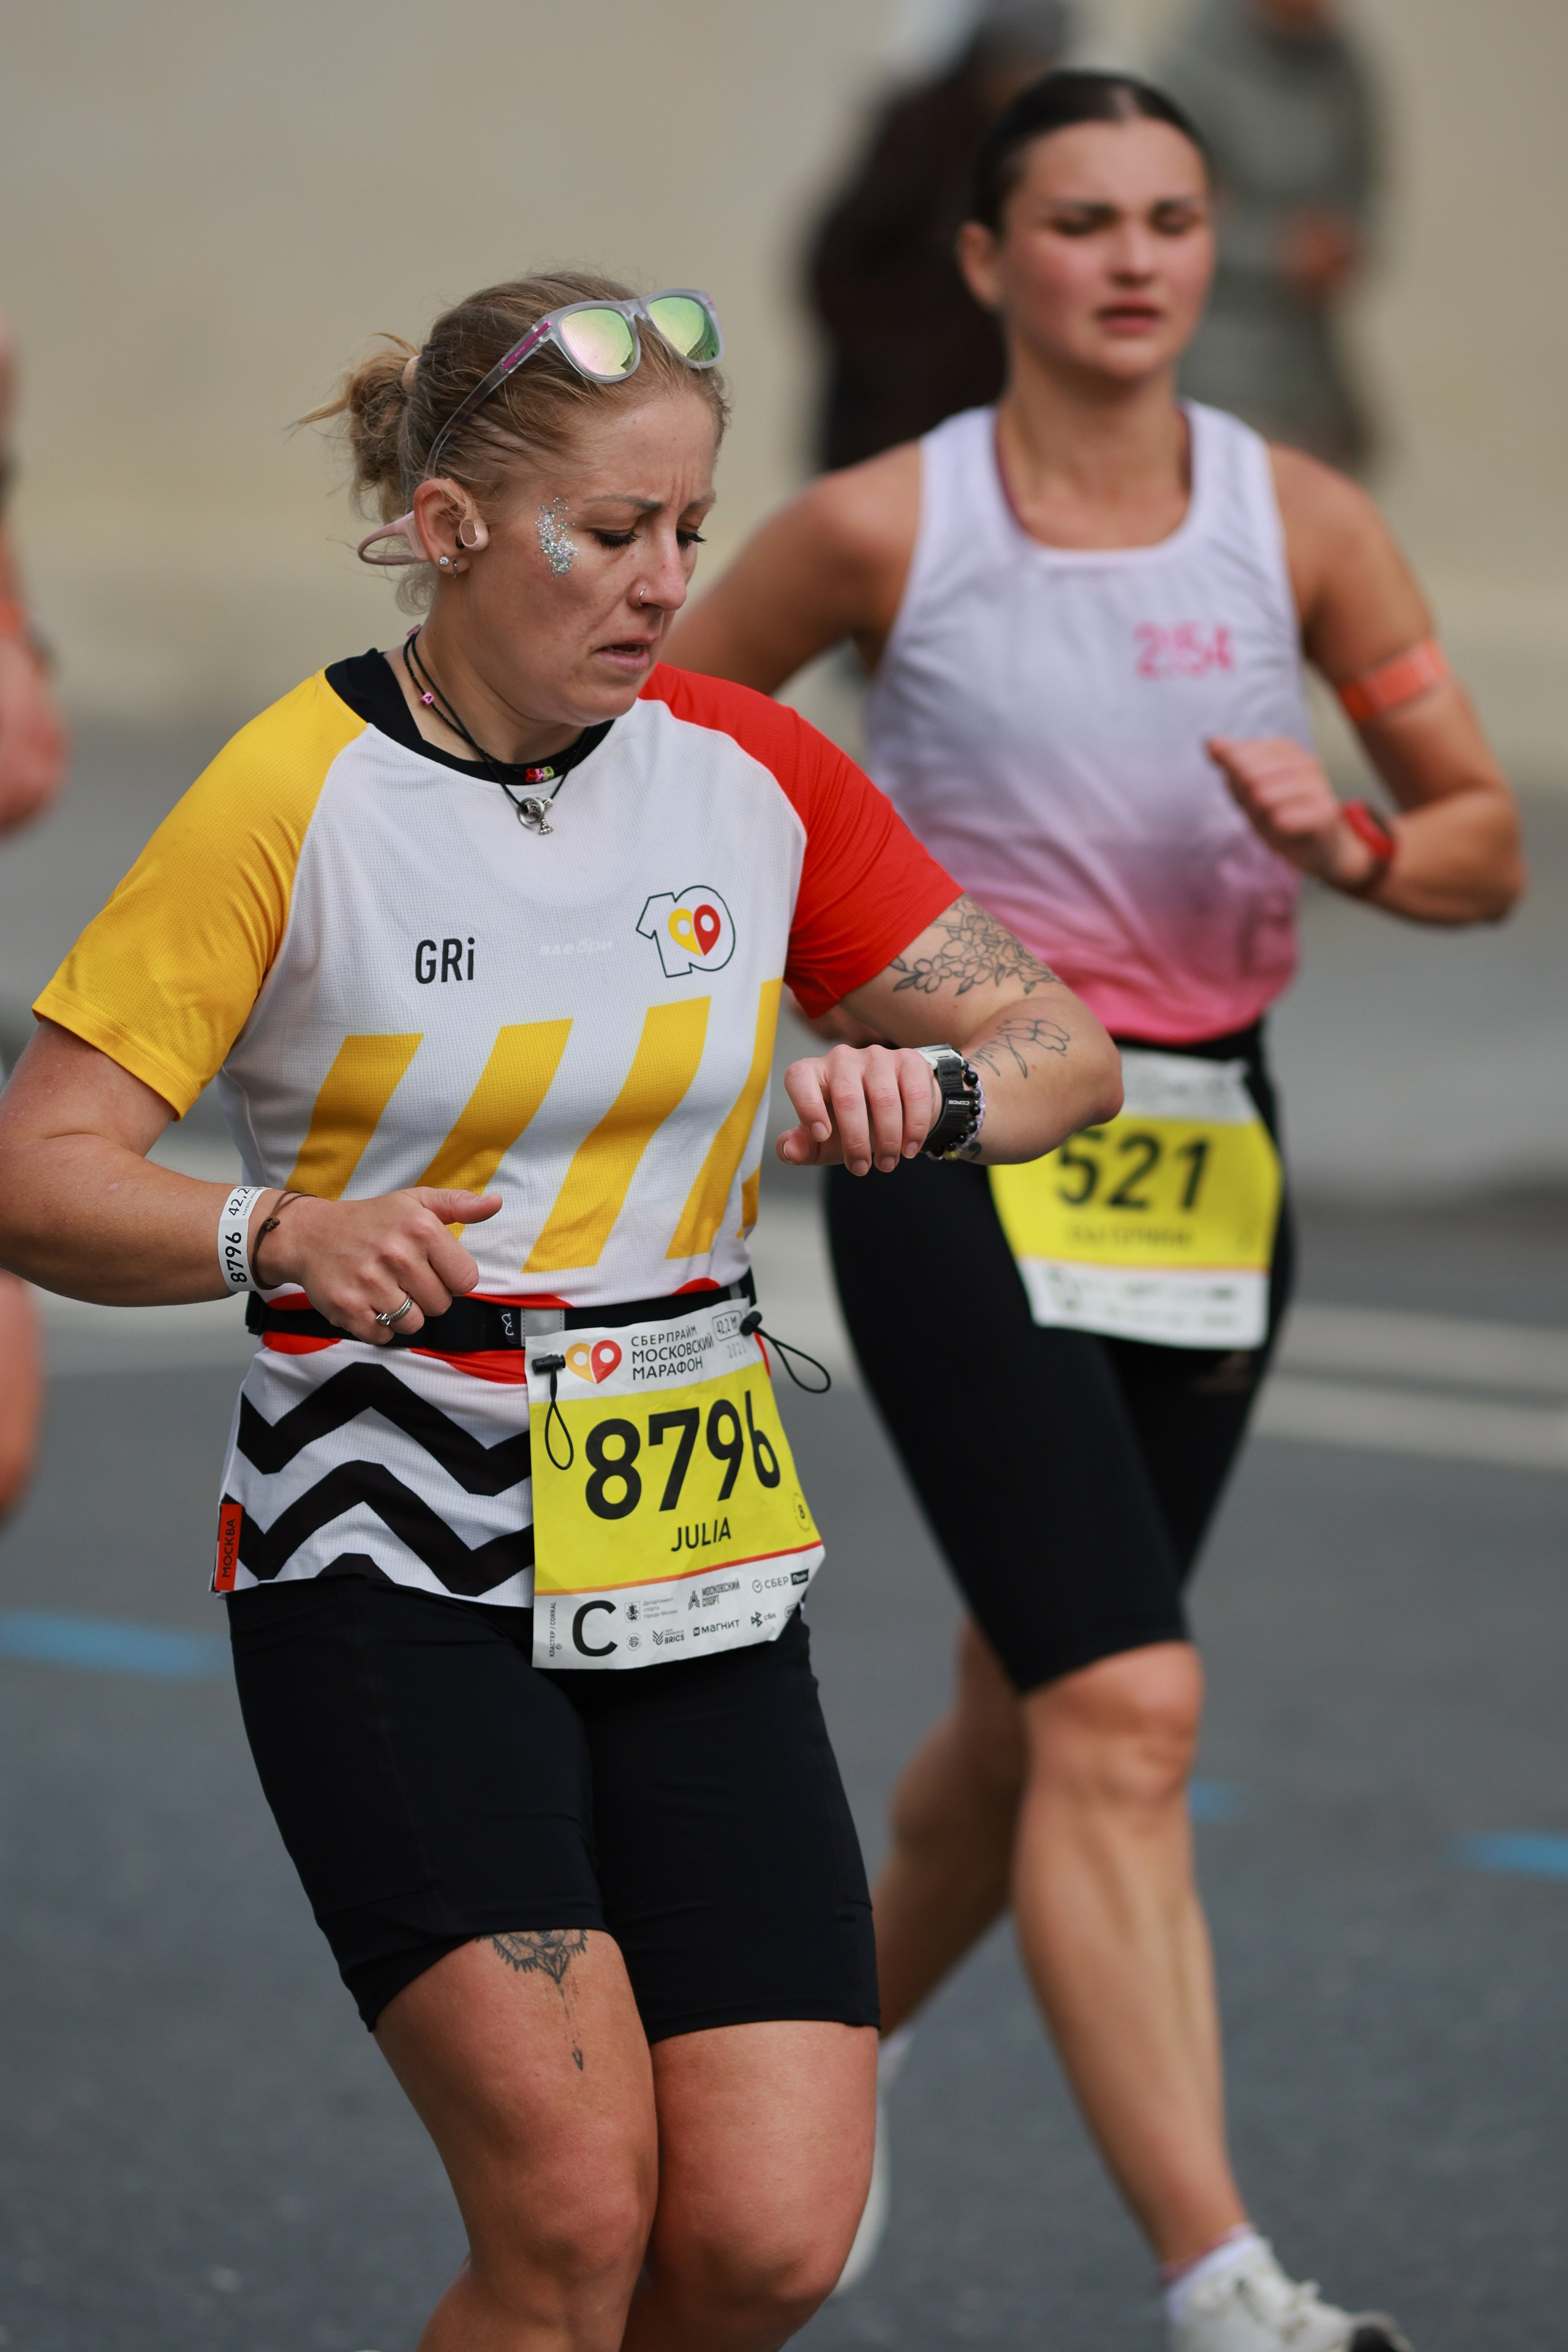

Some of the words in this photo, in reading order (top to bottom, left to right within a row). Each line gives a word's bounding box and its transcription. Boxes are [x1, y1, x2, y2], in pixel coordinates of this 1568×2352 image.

[415, 937, 476, 984] GRi
[1057, 1128, 1212, 1211] 521
[225, 1232, 247, 1283] 8796
[631, 1325, 697, 1347] СБЕРПРАЙМ
[631, 1332, 714, 1364] МОСКОВСКИЙ
[633, 1355, 703, 1381] МАРАФОН
[586, 1390, 781, 1521] 8796
[222, 1518, 236, 1577] МОСКВА
[671, 1517, 732, 1552] JULIA
[702, 1578, 740, 1597] МОСКОВСКИЙ
[764, 1575, 789, 1589] СБЕР
[702, 1594, 720, 1608] СПОРТ
[572, 1600, 618, 1657] C
[665, 1634, 684, 1645] BRICS
